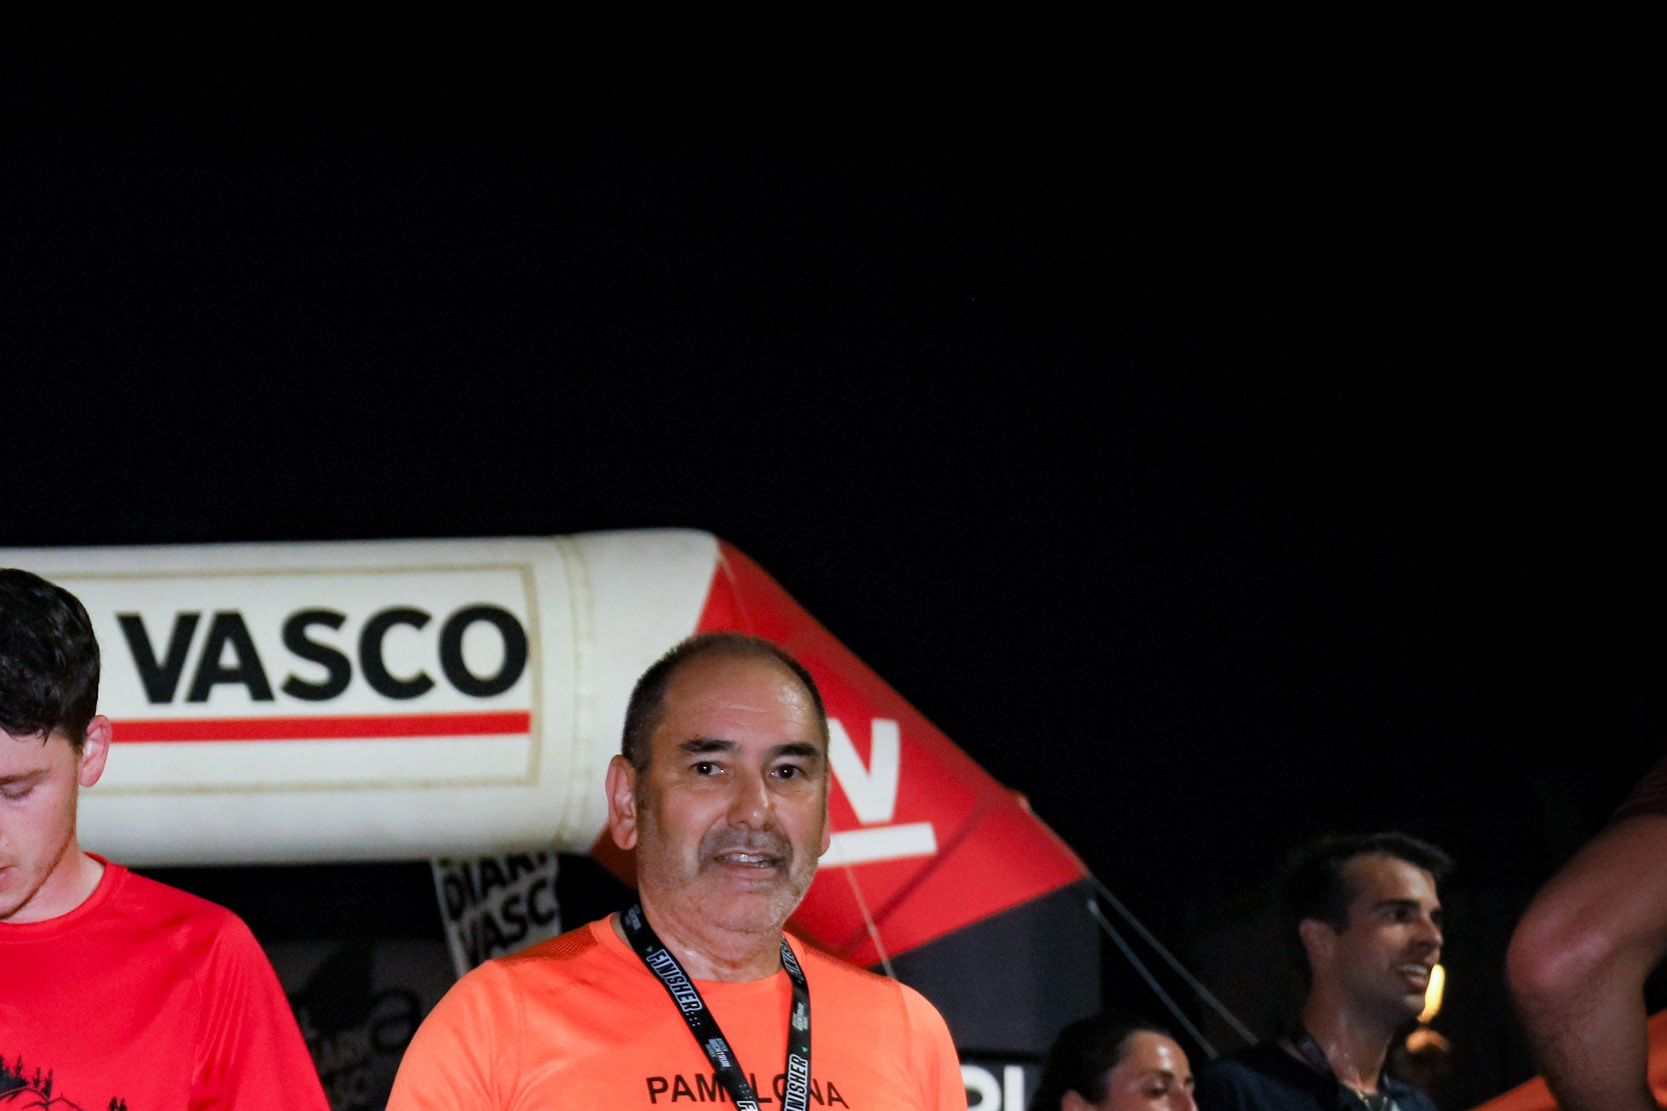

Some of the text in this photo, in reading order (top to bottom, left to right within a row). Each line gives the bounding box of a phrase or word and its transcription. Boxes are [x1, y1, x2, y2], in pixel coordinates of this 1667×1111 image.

[115, 602, 529, 704] VASCO
[827, 717, 901, 824] V
[646, 948, 703, 1013] FINISHER
